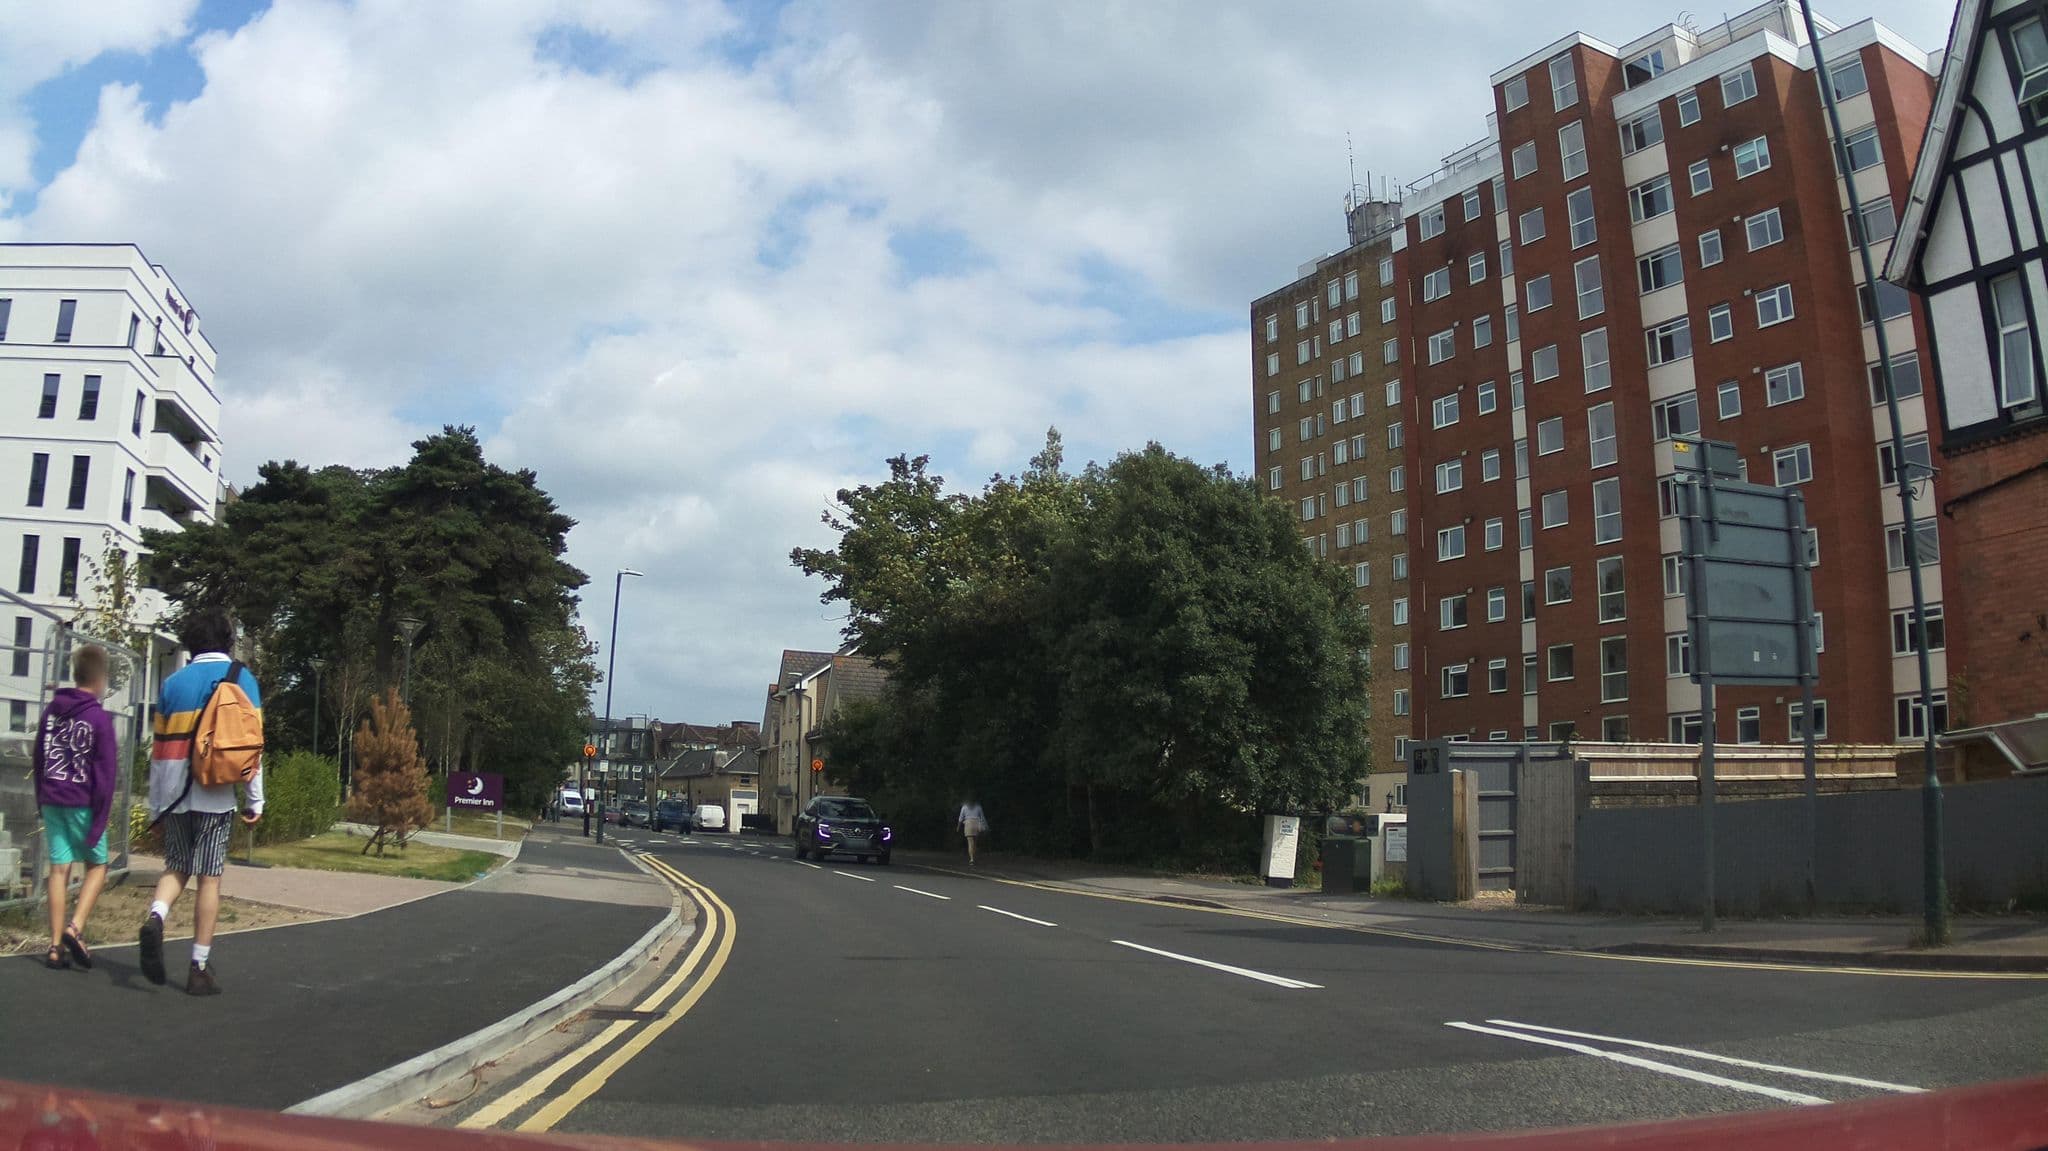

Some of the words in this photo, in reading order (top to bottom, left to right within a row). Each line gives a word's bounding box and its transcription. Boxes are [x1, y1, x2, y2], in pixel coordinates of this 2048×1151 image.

[52, 717, 93, 754] 20
[454, 796, 482, 805] Premier
[483, 798, 494, 806] Inn
